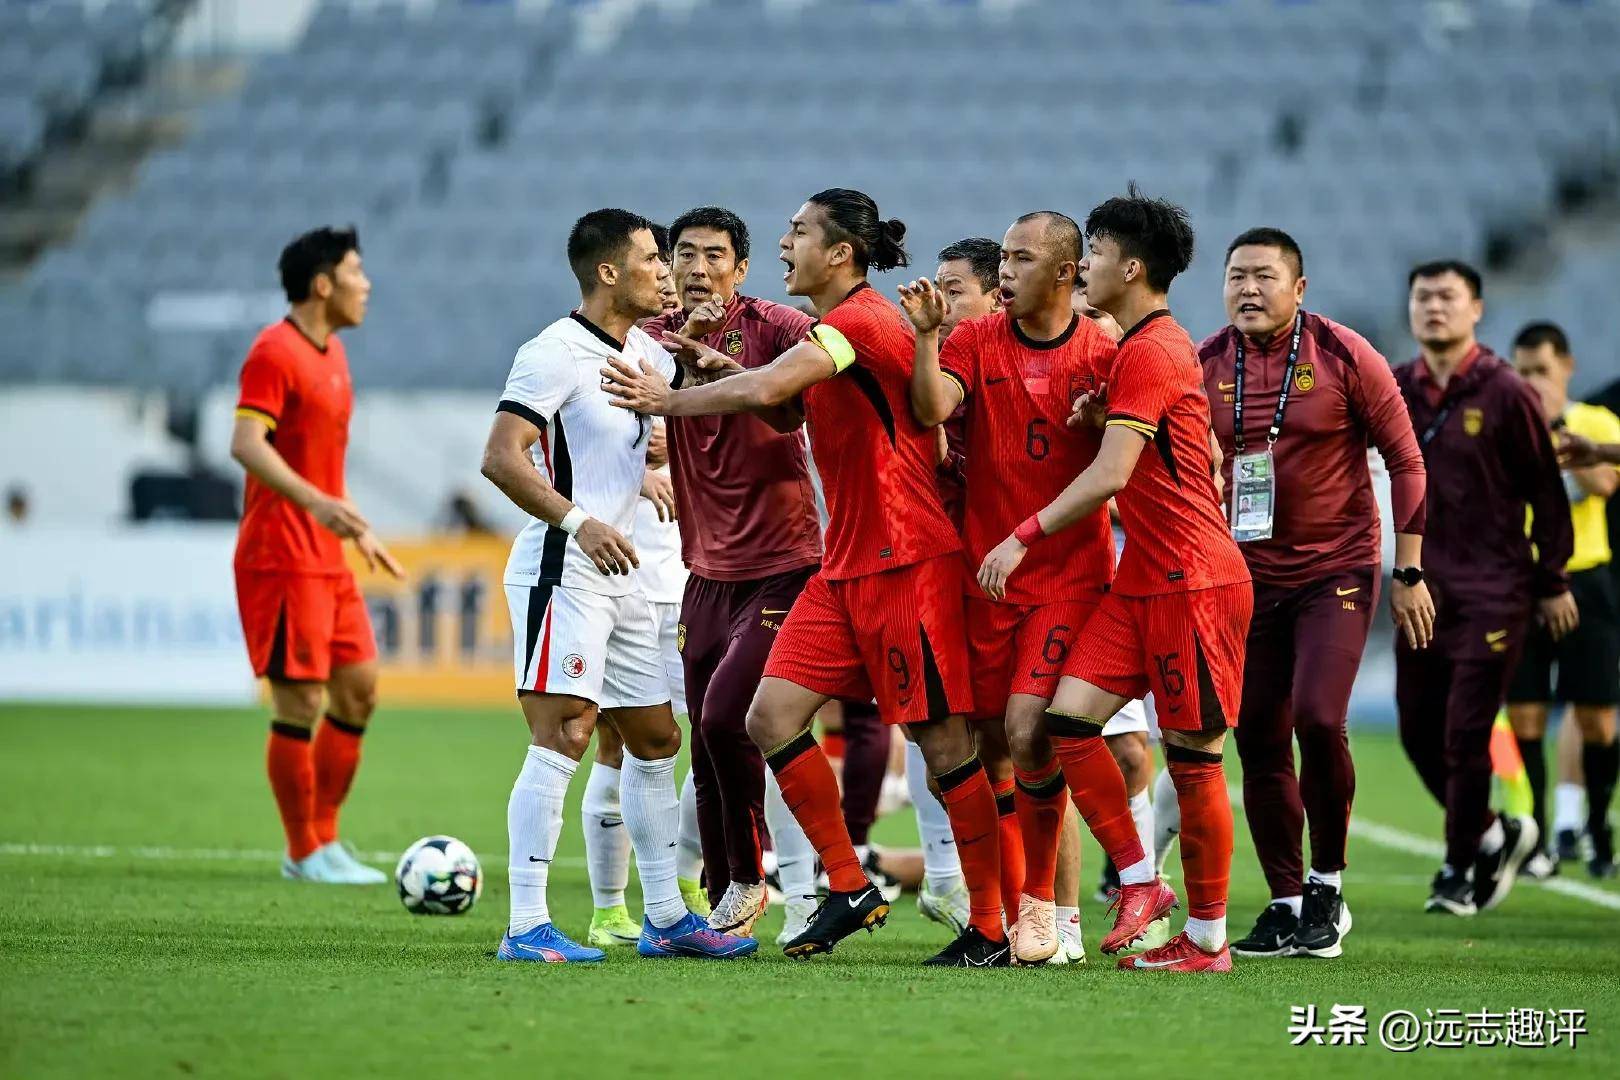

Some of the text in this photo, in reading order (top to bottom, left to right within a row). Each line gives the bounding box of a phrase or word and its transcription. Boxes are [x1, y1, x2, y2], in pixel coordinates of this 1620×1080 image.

[1027, 418, 1050, 461] 6
[1043, 626, 1068, 665] 6
[888, 649, 910, 689] 9
[1156, 653, 1184, 694] 15
